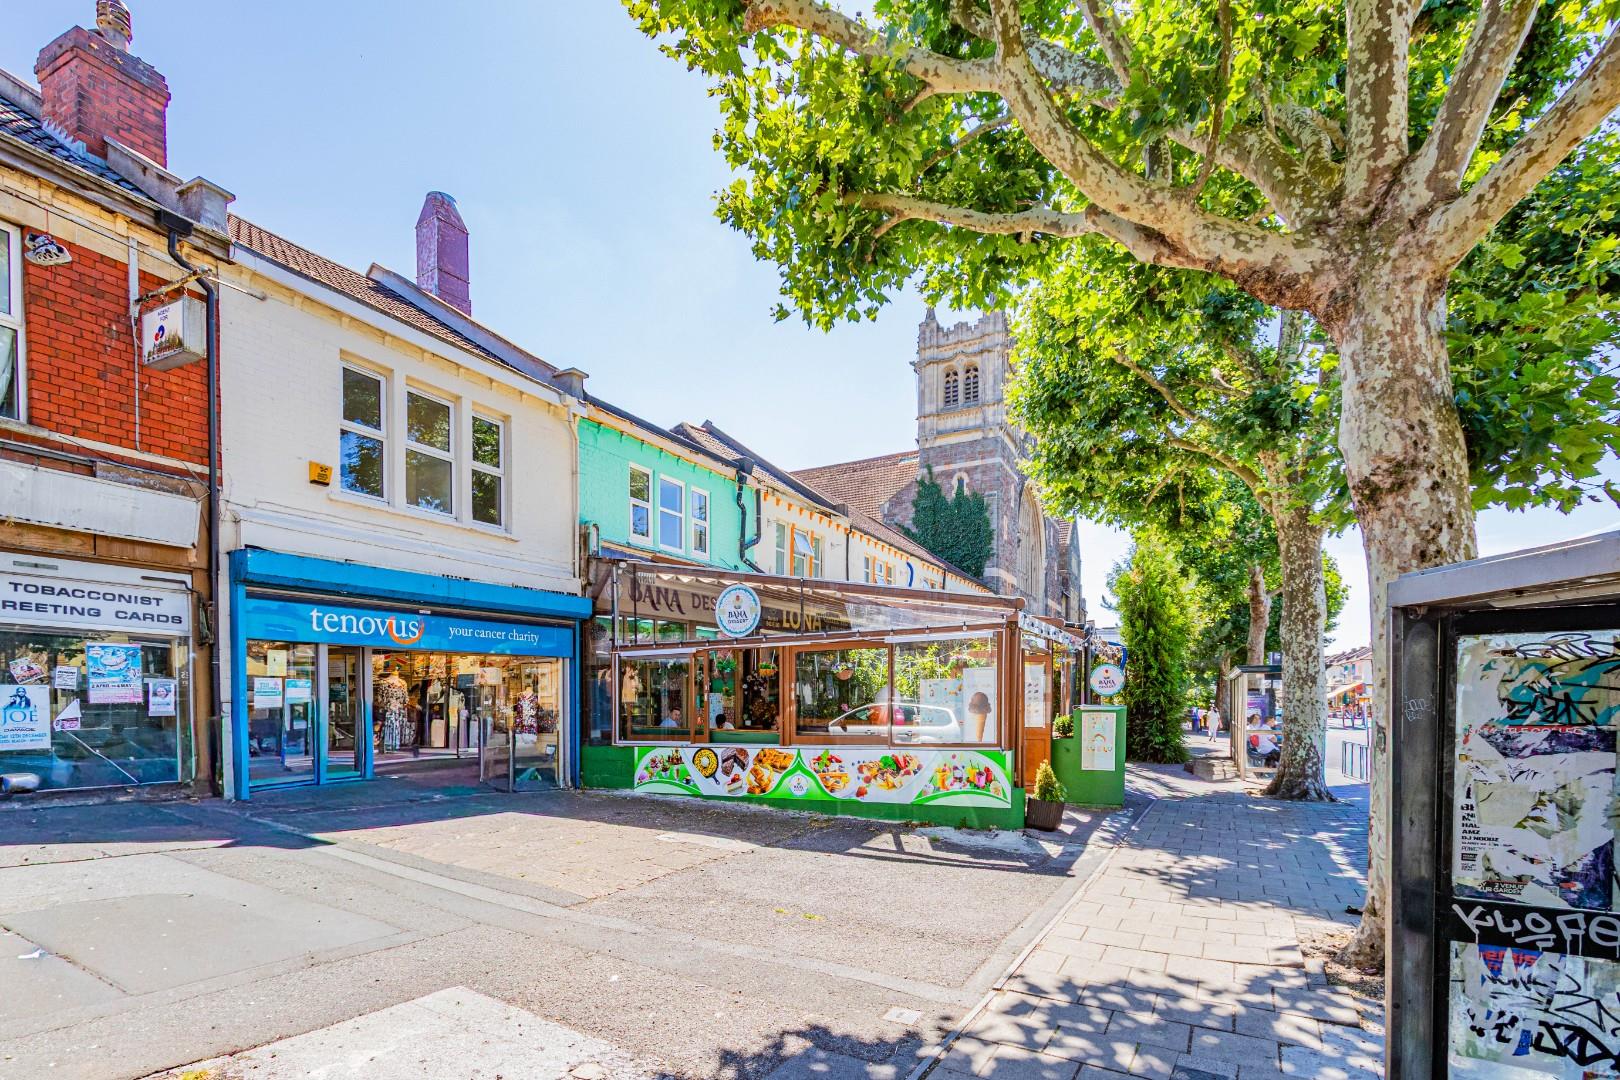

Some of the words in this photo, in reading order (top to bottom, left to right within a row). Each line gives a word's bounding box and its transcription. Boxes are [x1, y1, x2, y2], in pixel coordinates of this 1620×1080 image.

[9, 581, 164, 607] TOBACCONIST
[628, 577, 686, 615] BANA
[691, 592, 717, 612] DES
[1, 599, 102, 617] REETING
[115, 610, 183, 624] CARDS
[728, 609, 748, 619] BANA
[309, 607, 424, 645] tenovus
[449, 626, 474, 639] your
[474, 628, 506, 640] cancer
[508, 630, 540, 644] charity
[2, 707, 38, 726] JOE
